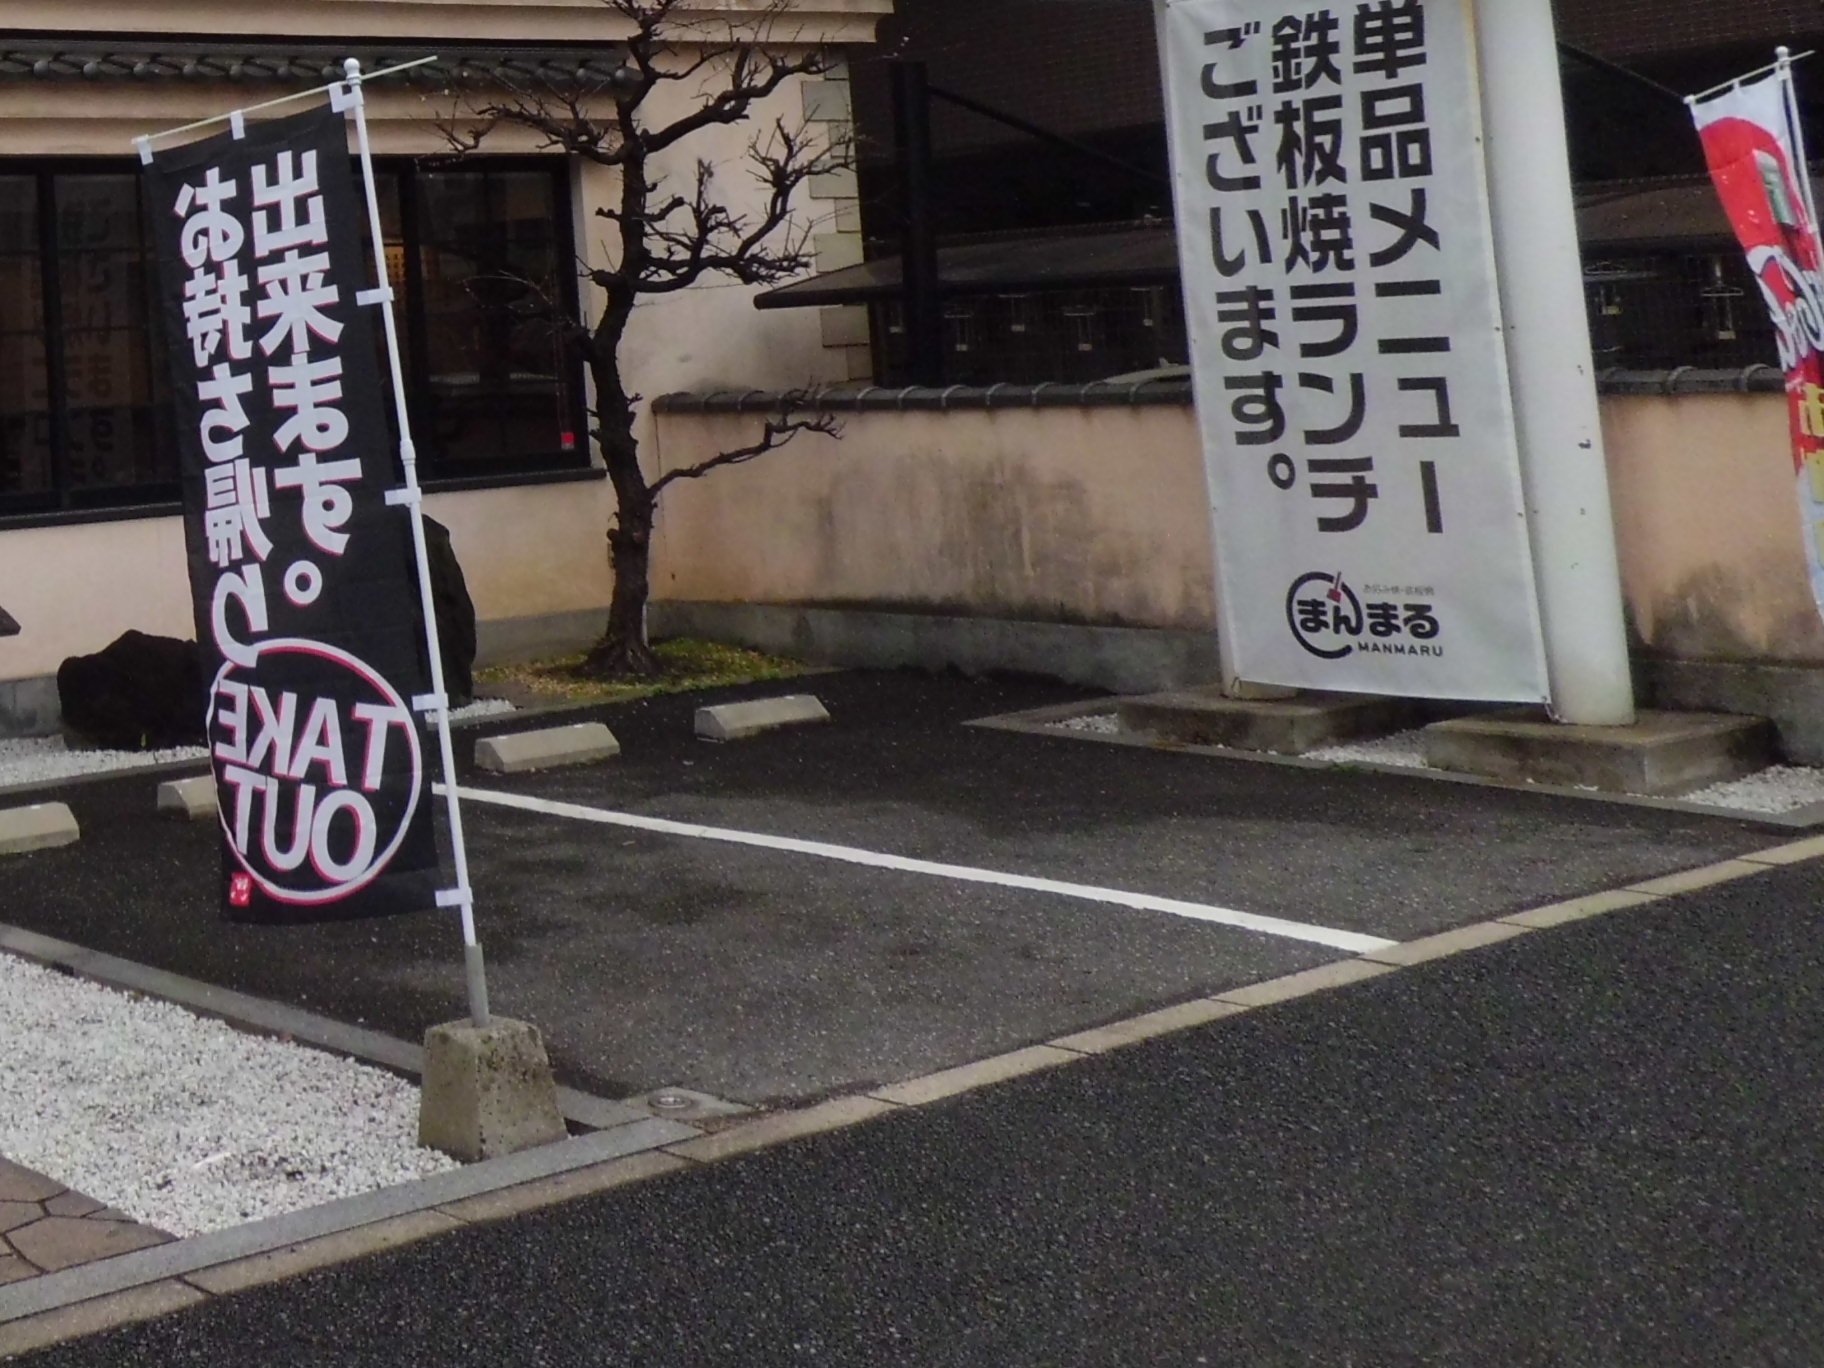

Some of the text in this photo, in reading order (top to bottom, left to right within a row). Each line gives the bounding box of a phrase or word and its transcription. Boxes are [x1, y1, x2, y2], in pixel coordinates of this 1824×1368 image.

[1200, 20, 1296, 491] ございます。
[1271, 8, 1379, 533] 鉄板焼ランチ
[1357, 641, 1443, 657] MANMARU
